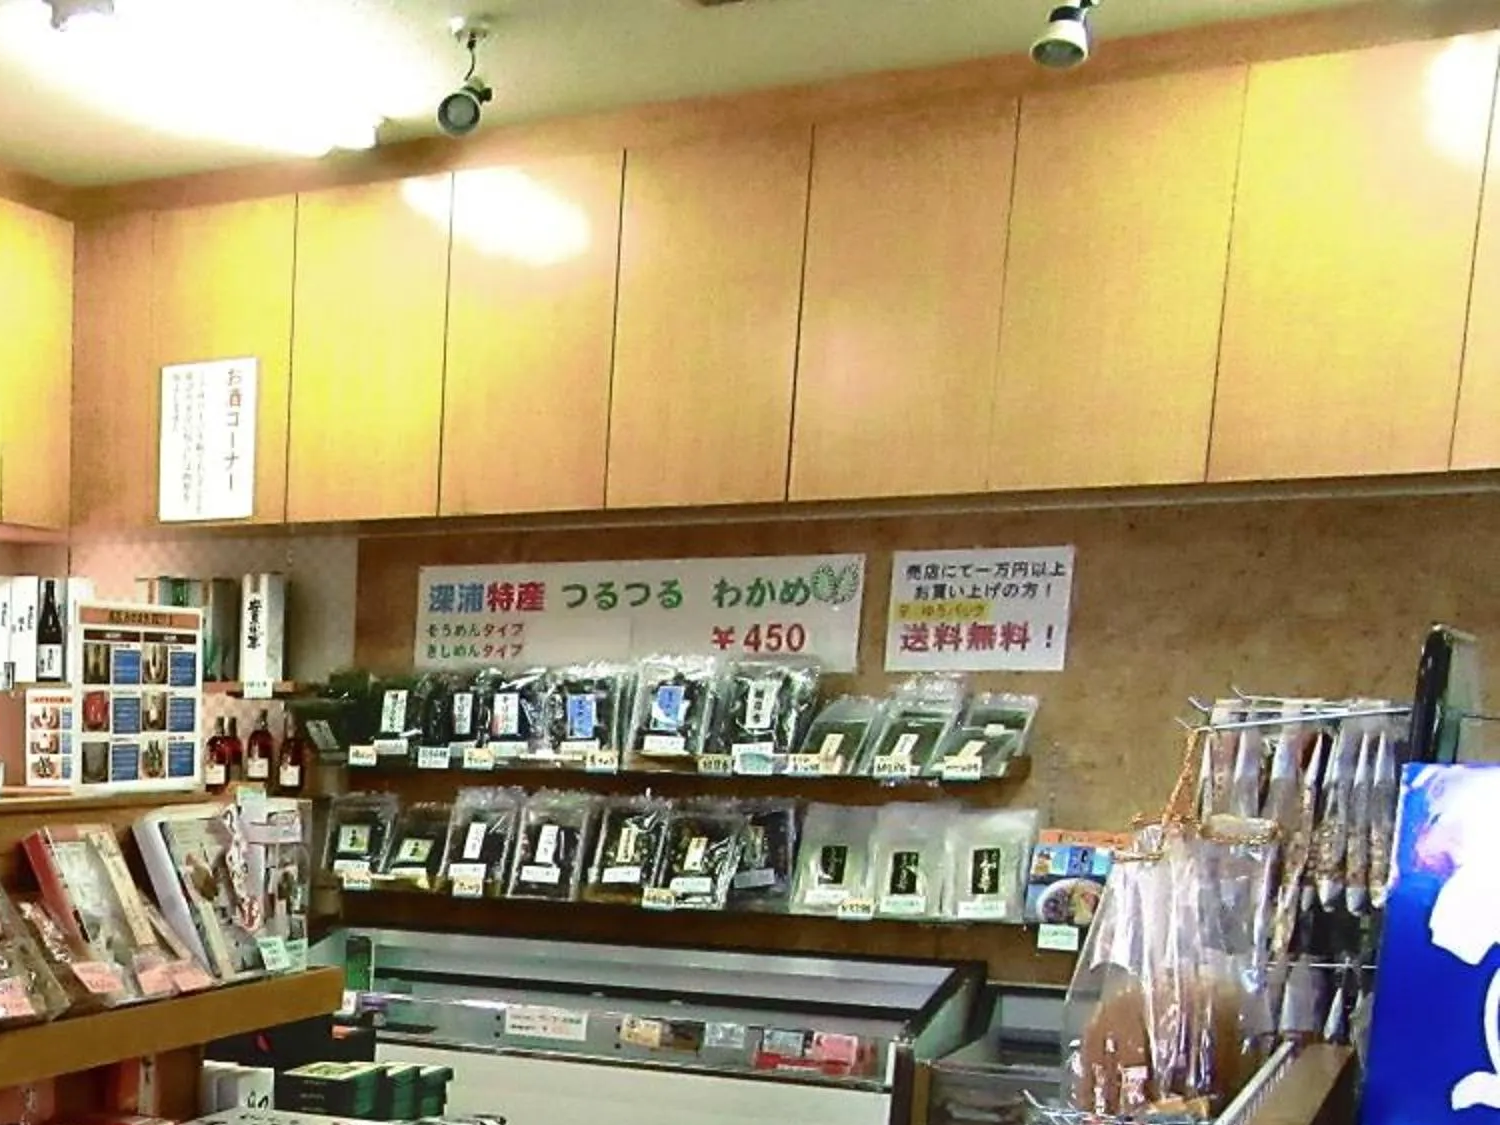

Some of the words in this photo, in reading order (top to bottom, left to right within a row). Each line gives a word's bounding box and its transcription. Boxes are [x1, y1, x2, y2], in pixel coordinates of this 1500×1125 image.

[905, 561, 1066, 581] 売店にて一万円以上
[428, 581, 545, 614] 深浦特産
[562, 581, 684, 611] つるつる
[712, 577, 812, 609] わかめ
[914, 581, 1052, 600] お買い上げの方！
[426, 623, 525, 638] そうめんタイプ
[712, 624, 806, 653] ¥450
[426, 643, 524, 660] きしめんタイプ
